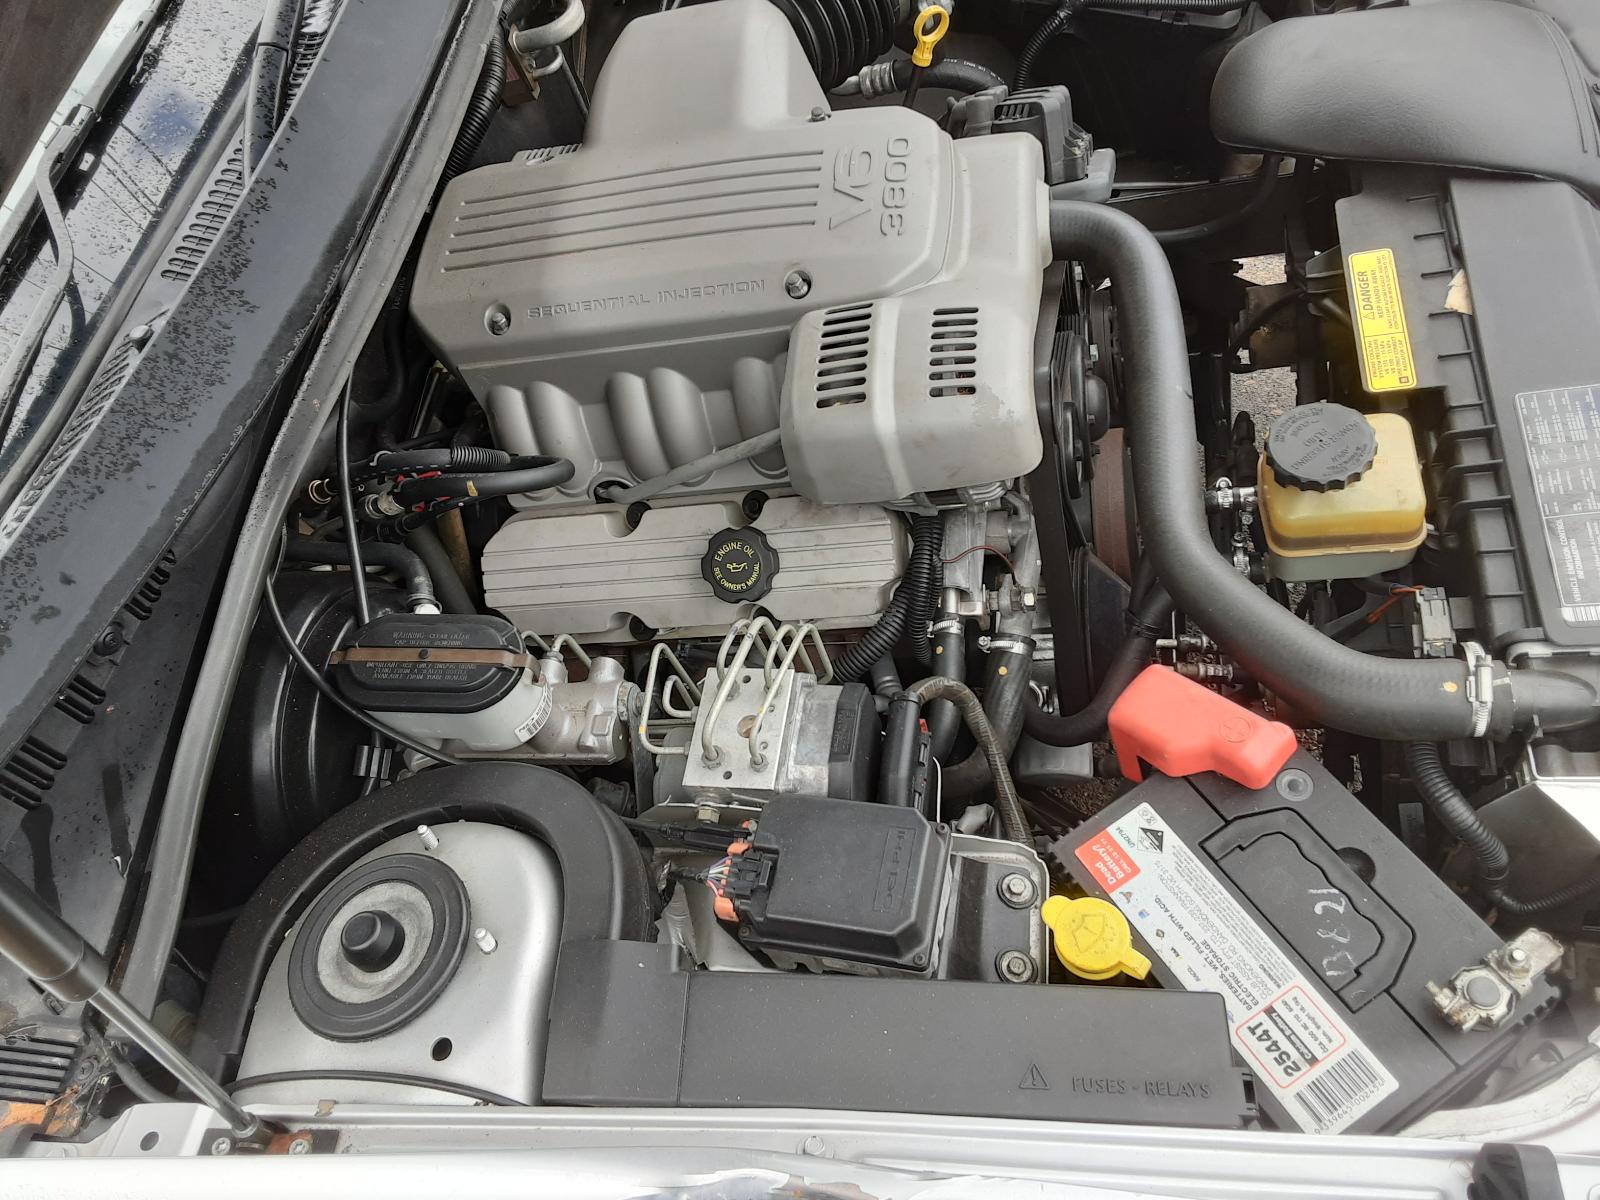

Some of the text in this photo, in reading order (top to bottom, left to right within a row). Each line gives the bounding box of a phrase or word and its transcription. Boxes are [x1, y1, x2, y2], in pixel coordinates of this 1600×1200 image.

[828, 149, 871, 230] V6
[879, 137, 908, 236] 3800
[526, 277, 766, 320] SEQUENTIAL INJECTION
[1356, 270, 1373, 311] DANGER
[1373, 285, 1381, 303] HANDS
[1555, 518, 1568, 545] CONTROL
[714, 541, 754, 561] ENGINE OIL
[1568, 537, 1585, 579] INFORMATION
[713, 567, 722, 580] SEE
[746, 561, 760, 586] MANUAL
[1569, 576, 1581, 601] VEHICLE
[1115, 824, 1136, 848] UN2794
[1091, 841, 1125, 880] Battery?
[1093, 860, 1117, 885] Dead
[1118, 858, 1132, 873] CALL
[1174, 882, 1195, 906] SOUTH
[1168, 912, 1185, 931] WITH
[1182, 929, 1204, 954] FILLED
[1200, 938, 1230, 972] STORAGE
[1227, 971, 1259, 1006] ELECTRIC
[1270, 1010, 1292, 1035] Battery
[1245, 1017, 1302, 1079] 2544T
[1072, 1075, 1126, 1094] FUSES
[1144, 1078, 1210, 1098] RELAYS
